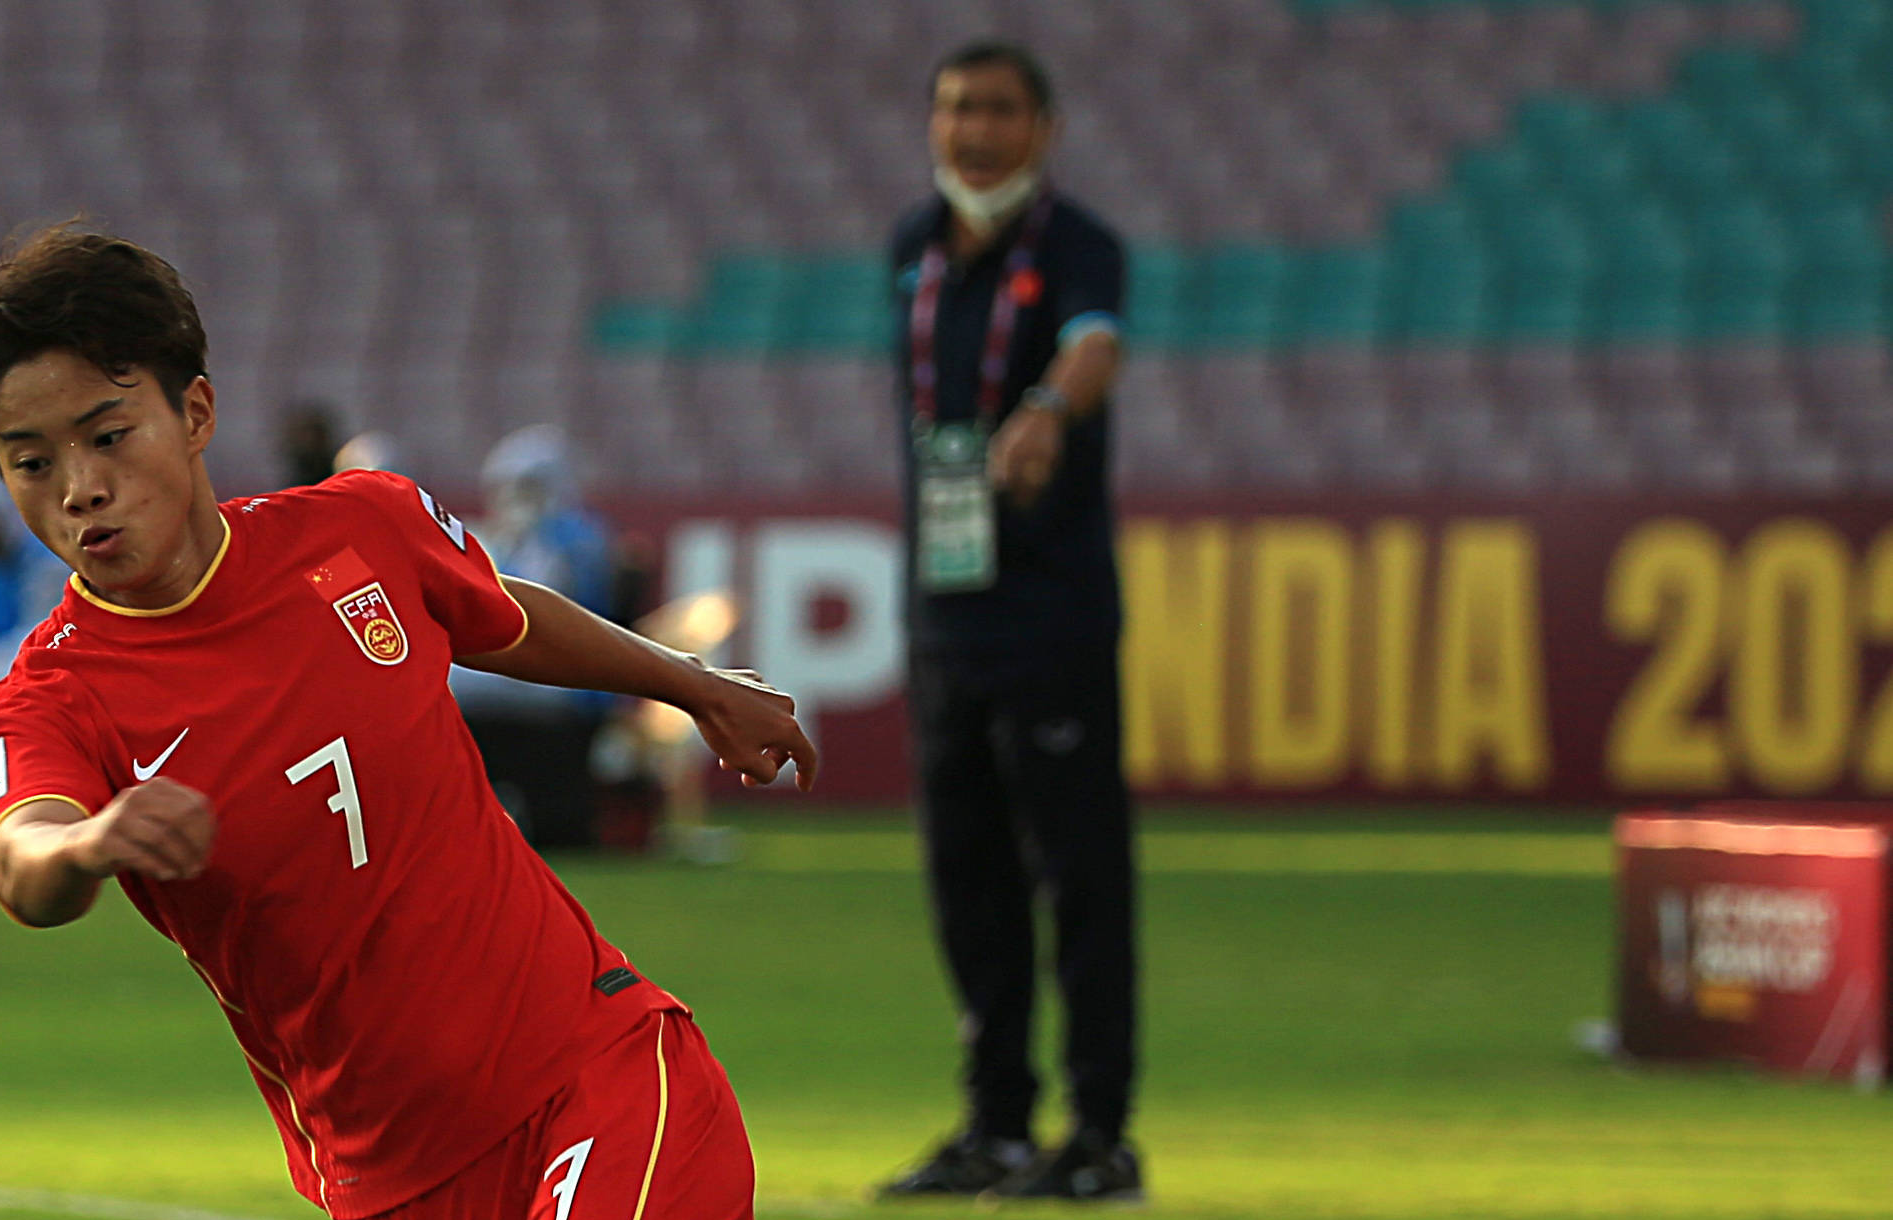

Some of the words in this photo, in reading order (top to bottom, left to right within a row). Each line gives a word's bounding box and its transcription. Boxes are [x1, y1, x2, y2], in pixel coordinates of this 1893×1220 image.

[342, 590, 383, 619] CFA
[1116, 517, 1546, 784] NDIA
[284, 735, 369, 870] 7
